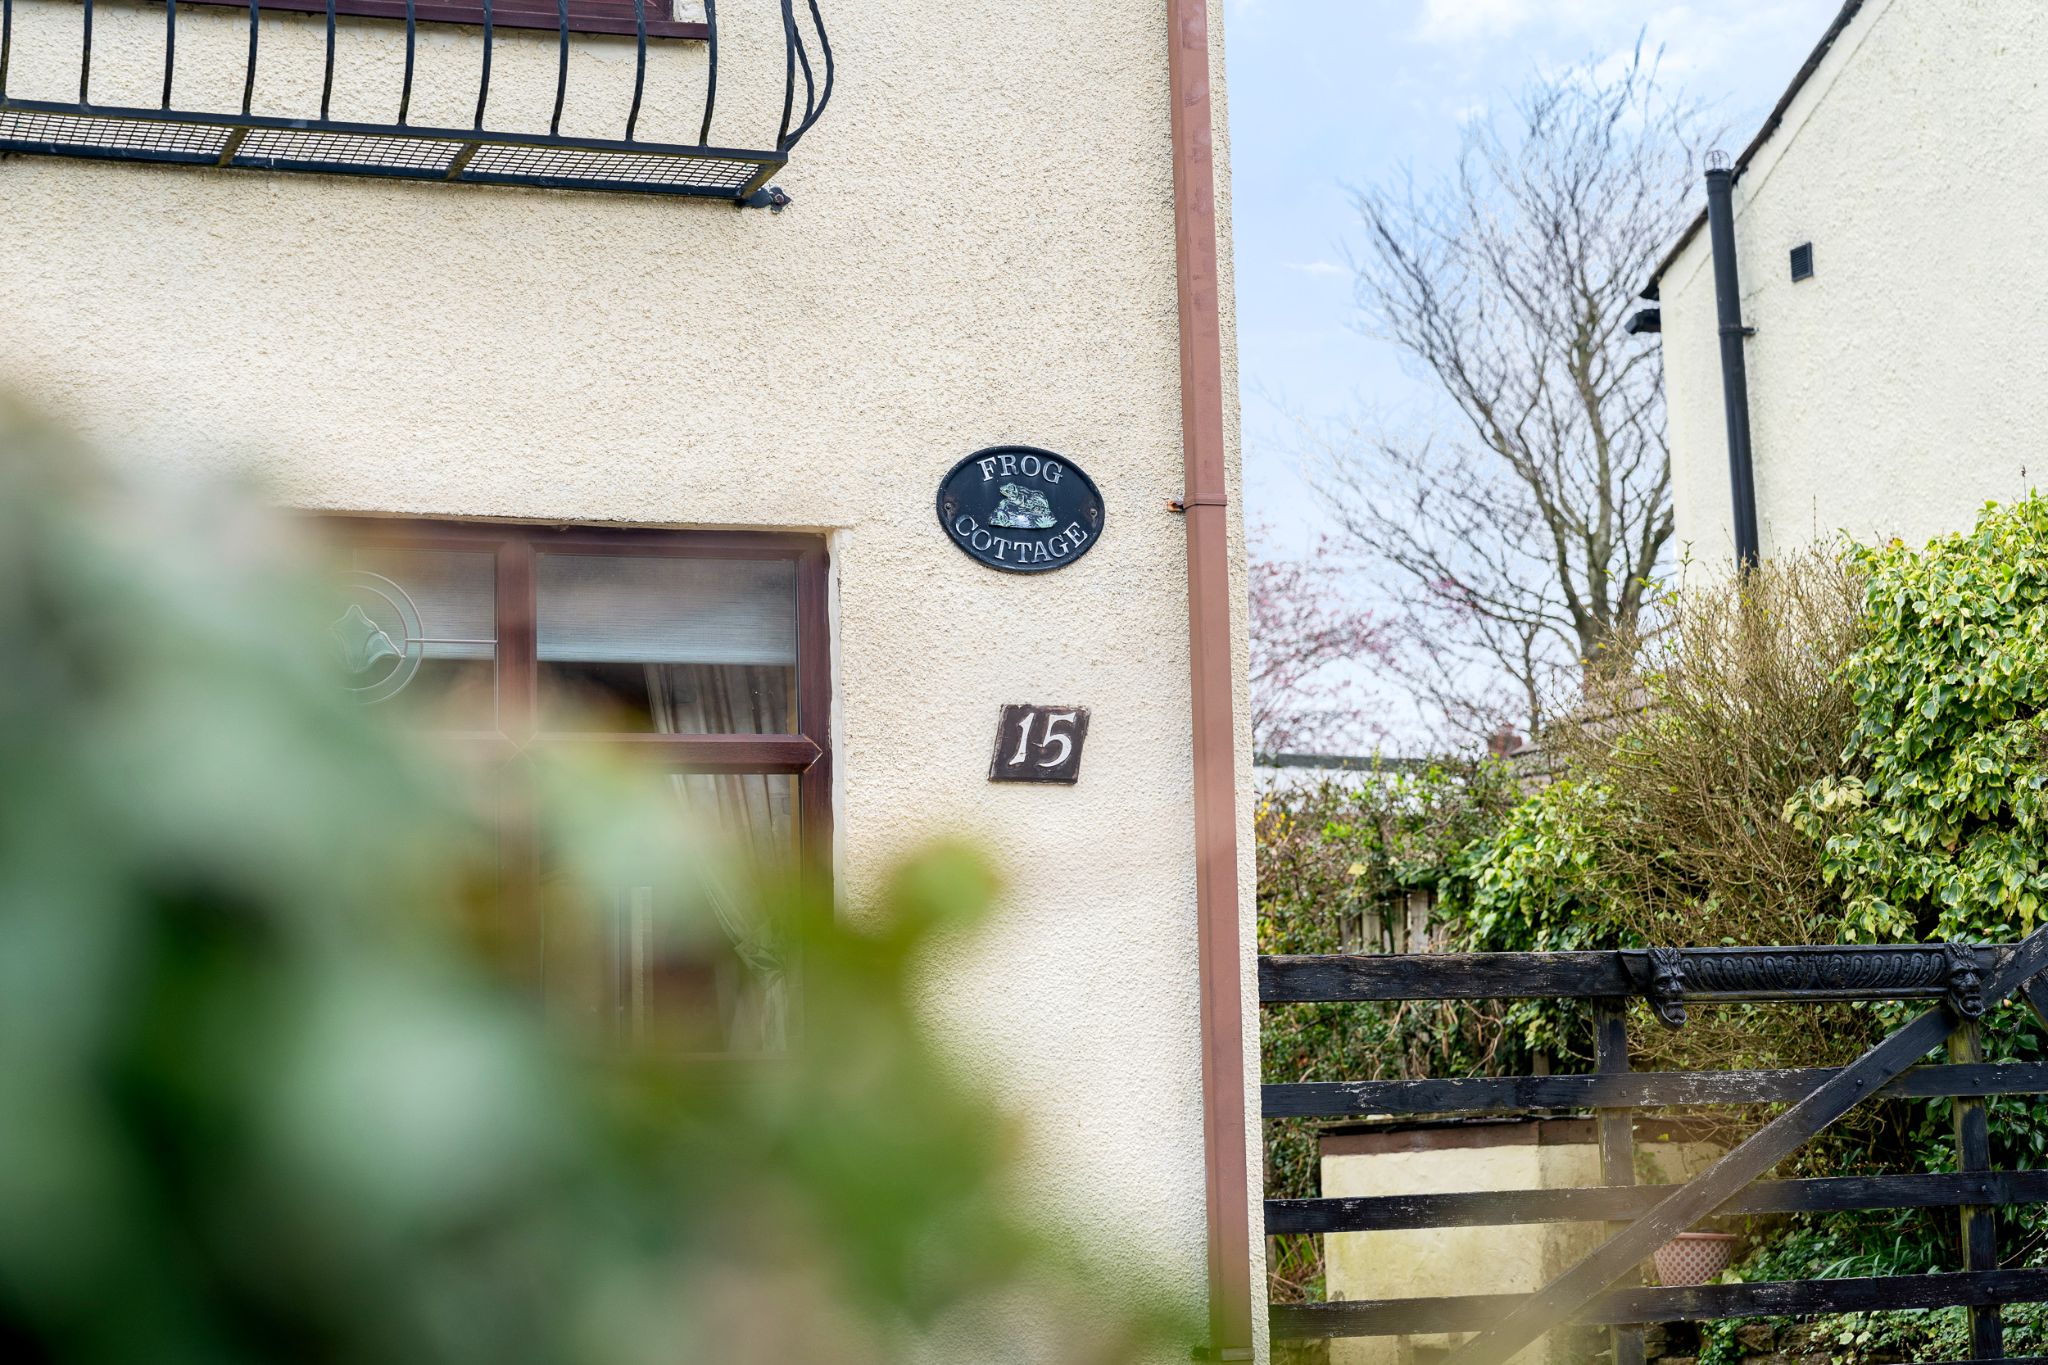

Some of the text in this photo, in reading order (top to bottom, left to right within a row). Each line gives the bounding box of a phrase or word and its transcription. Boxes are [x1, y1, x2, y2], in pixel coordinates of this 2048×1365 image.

[976, 454, 1064, 484] FROG
[955, 514, 1088, 564] COTTAGE
[1008, 712, 1077, 768] 15
